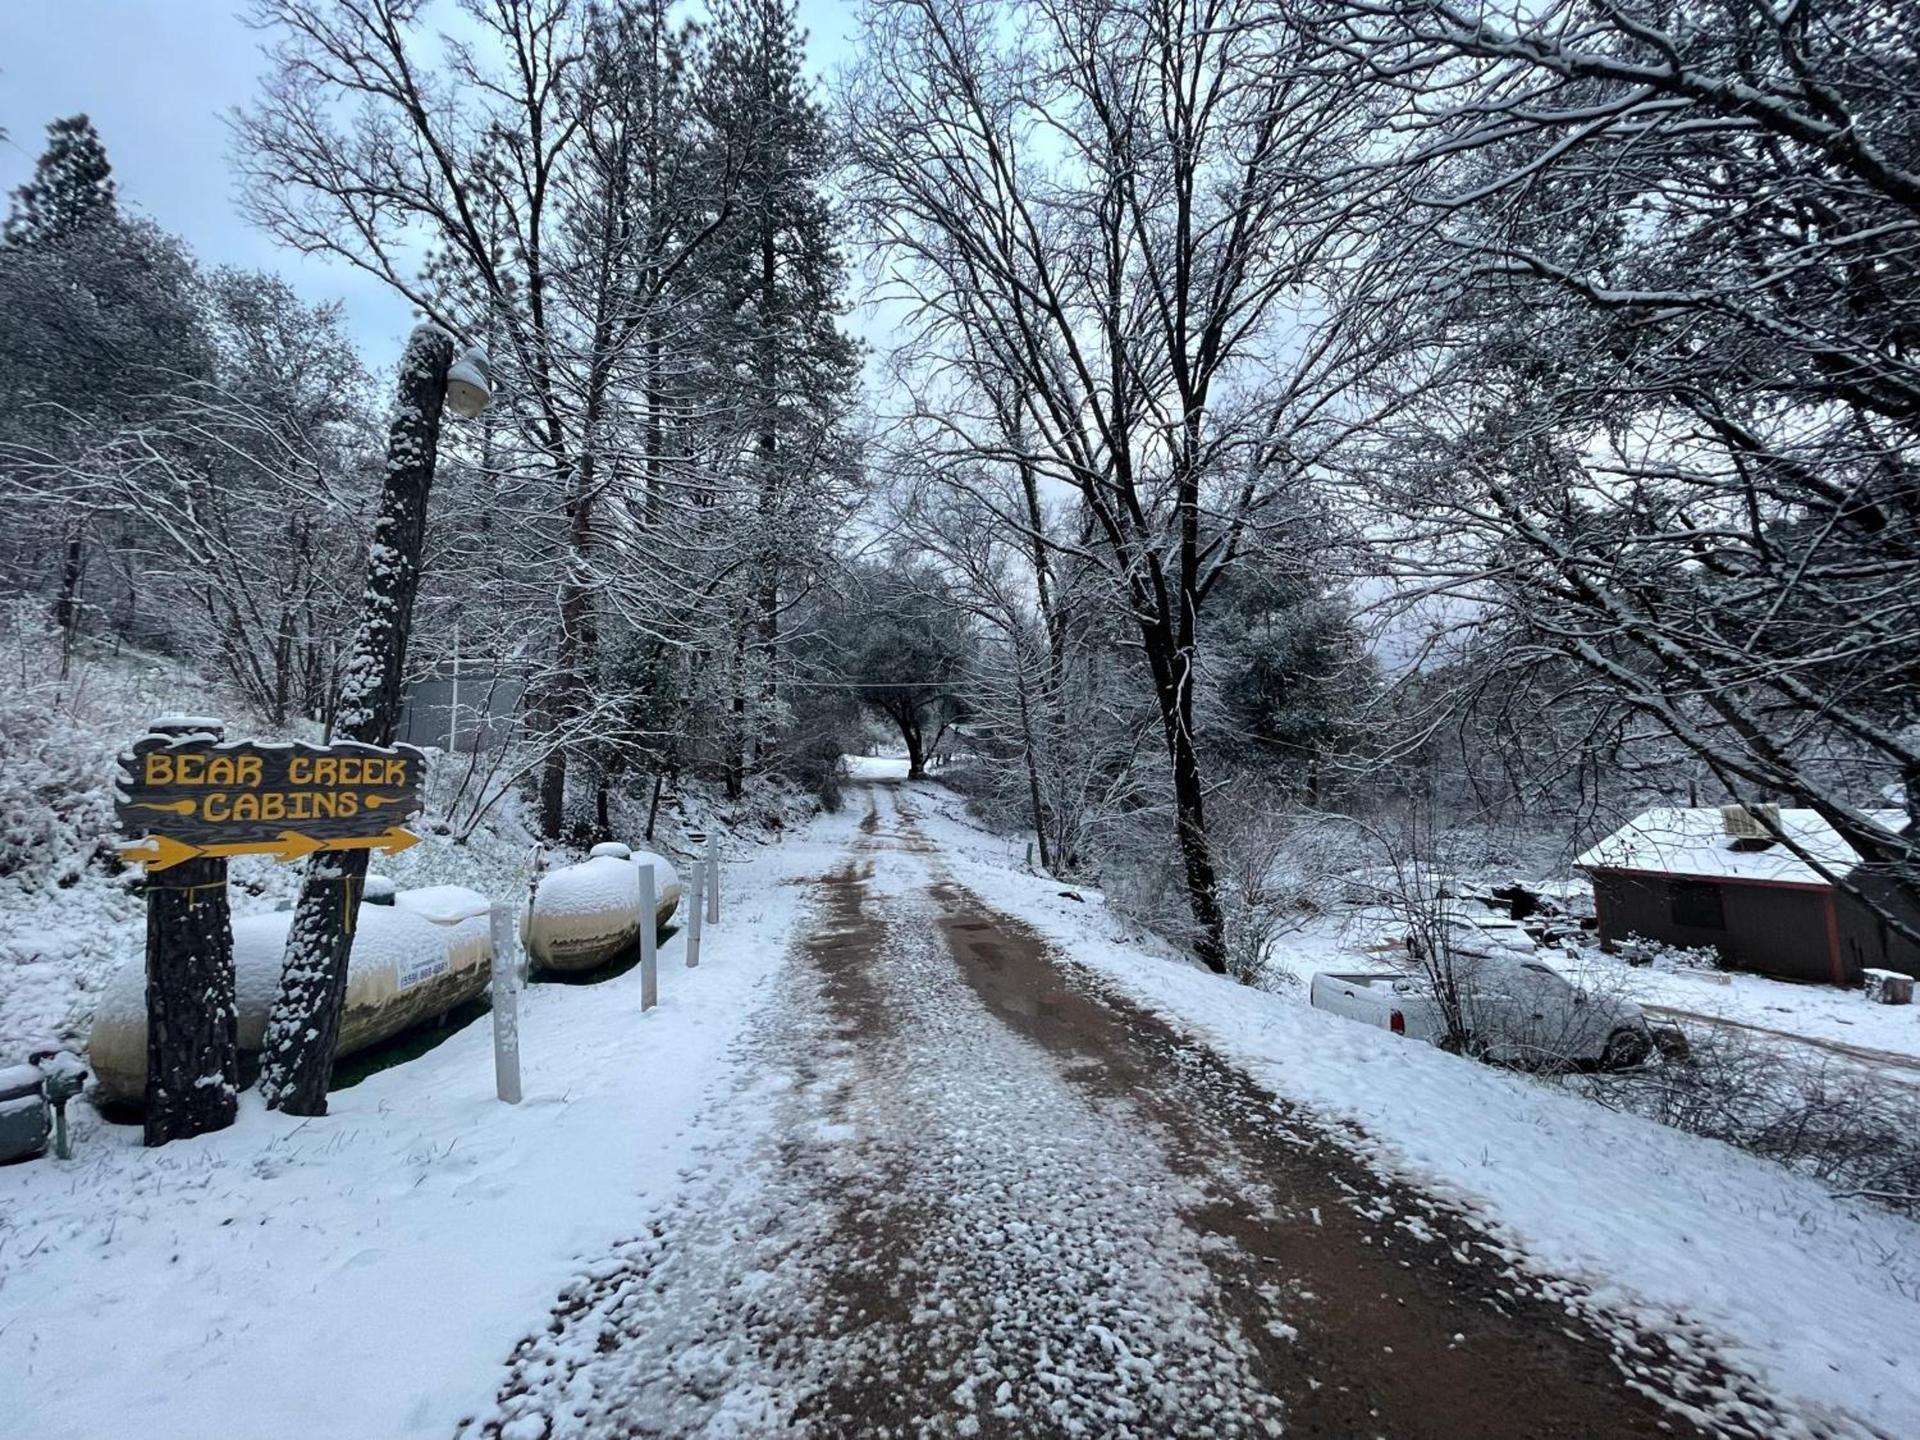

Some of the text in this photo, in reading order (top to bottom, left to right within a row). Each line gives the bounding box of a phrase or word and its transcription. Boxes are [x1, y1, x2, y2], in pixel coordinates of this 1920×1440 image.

[145, 753, 405, 787] BEAR CREEK
[202, 791, 359, 822] CABINS
